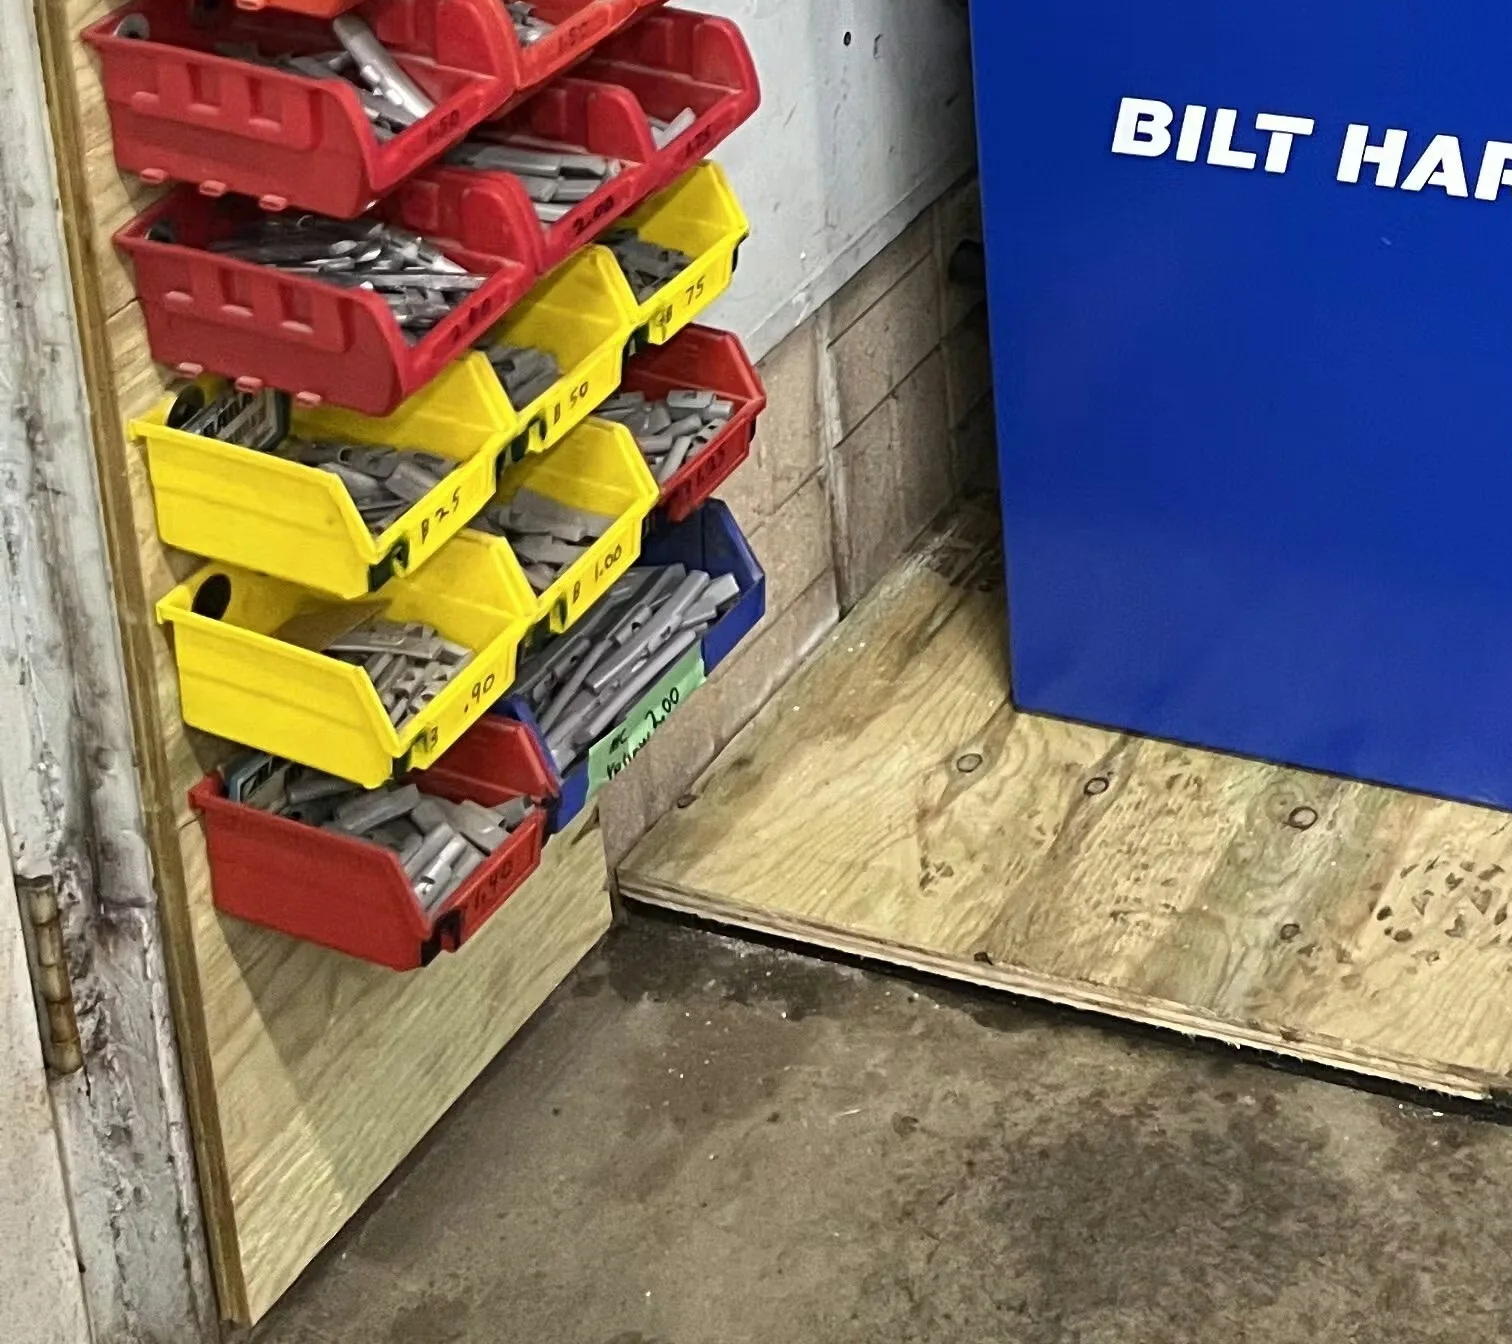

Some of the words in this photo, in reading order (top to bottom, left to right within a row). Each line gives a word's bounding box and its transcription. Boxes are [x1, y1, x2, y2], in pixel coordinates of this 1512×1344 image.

[1111, 96, 1315, 174] BILT
[685, 274, 705, 306] 75
[569, 380, 589, 404] 50
[594, 543, 623, 581] 1.00
[463, 672, 495, 714] .90
